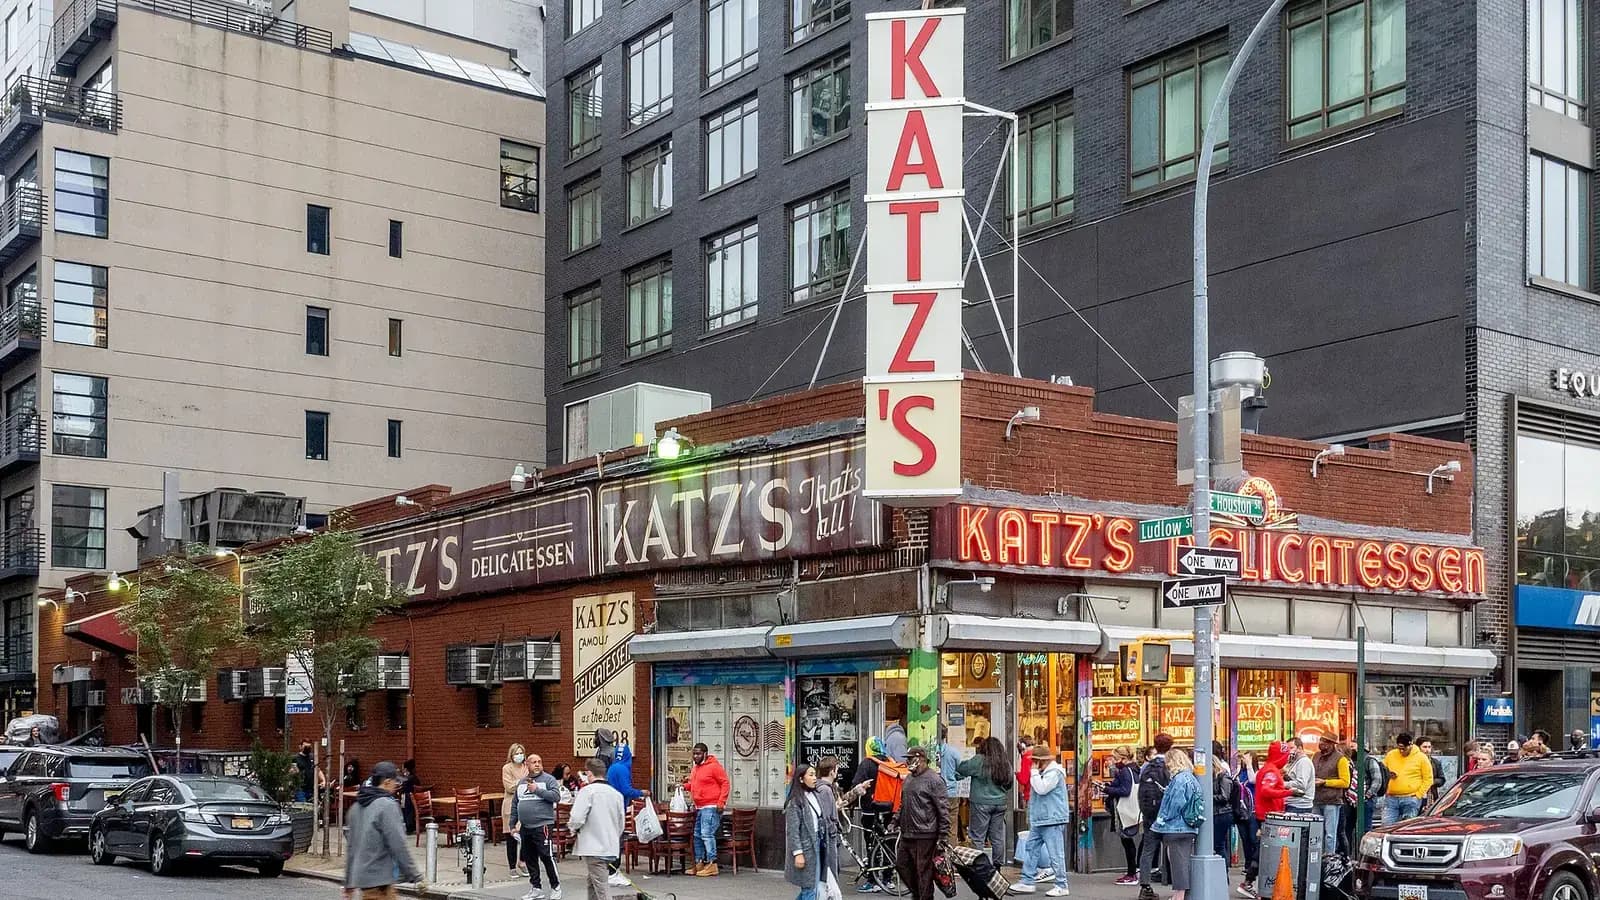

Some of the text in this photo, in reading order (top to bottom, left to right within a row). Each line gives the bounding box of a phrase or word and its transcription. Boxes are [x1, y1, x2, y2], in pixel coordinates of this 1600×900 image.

[878, 18, 944, 477] KATZ'S
[1210, 494, 1214, 509] E
[1217, 495, 1252, 514] Houston
[604, 478, 793, 566] KATZ'S
[1141, 521, 1182, 540] Ludlow
[960, 506, 1134, 572] KATZ'S
[471, 541, 575, 579] DELICATESSEN
[1187, 556, 1234, 569] ONE WAY
[1172, 586, 1217, 599] ONE WAY
[576, 600, 629, 629] KATZ'S
[597, 694, 627, 706] KNOWN
[581, 707, 622, 723] as the Best
[1238, 703, 1273, 719] ATZ'S
[577, 737, 594, 749] SINC
[806, 746, 853, 755] The Real Taste
